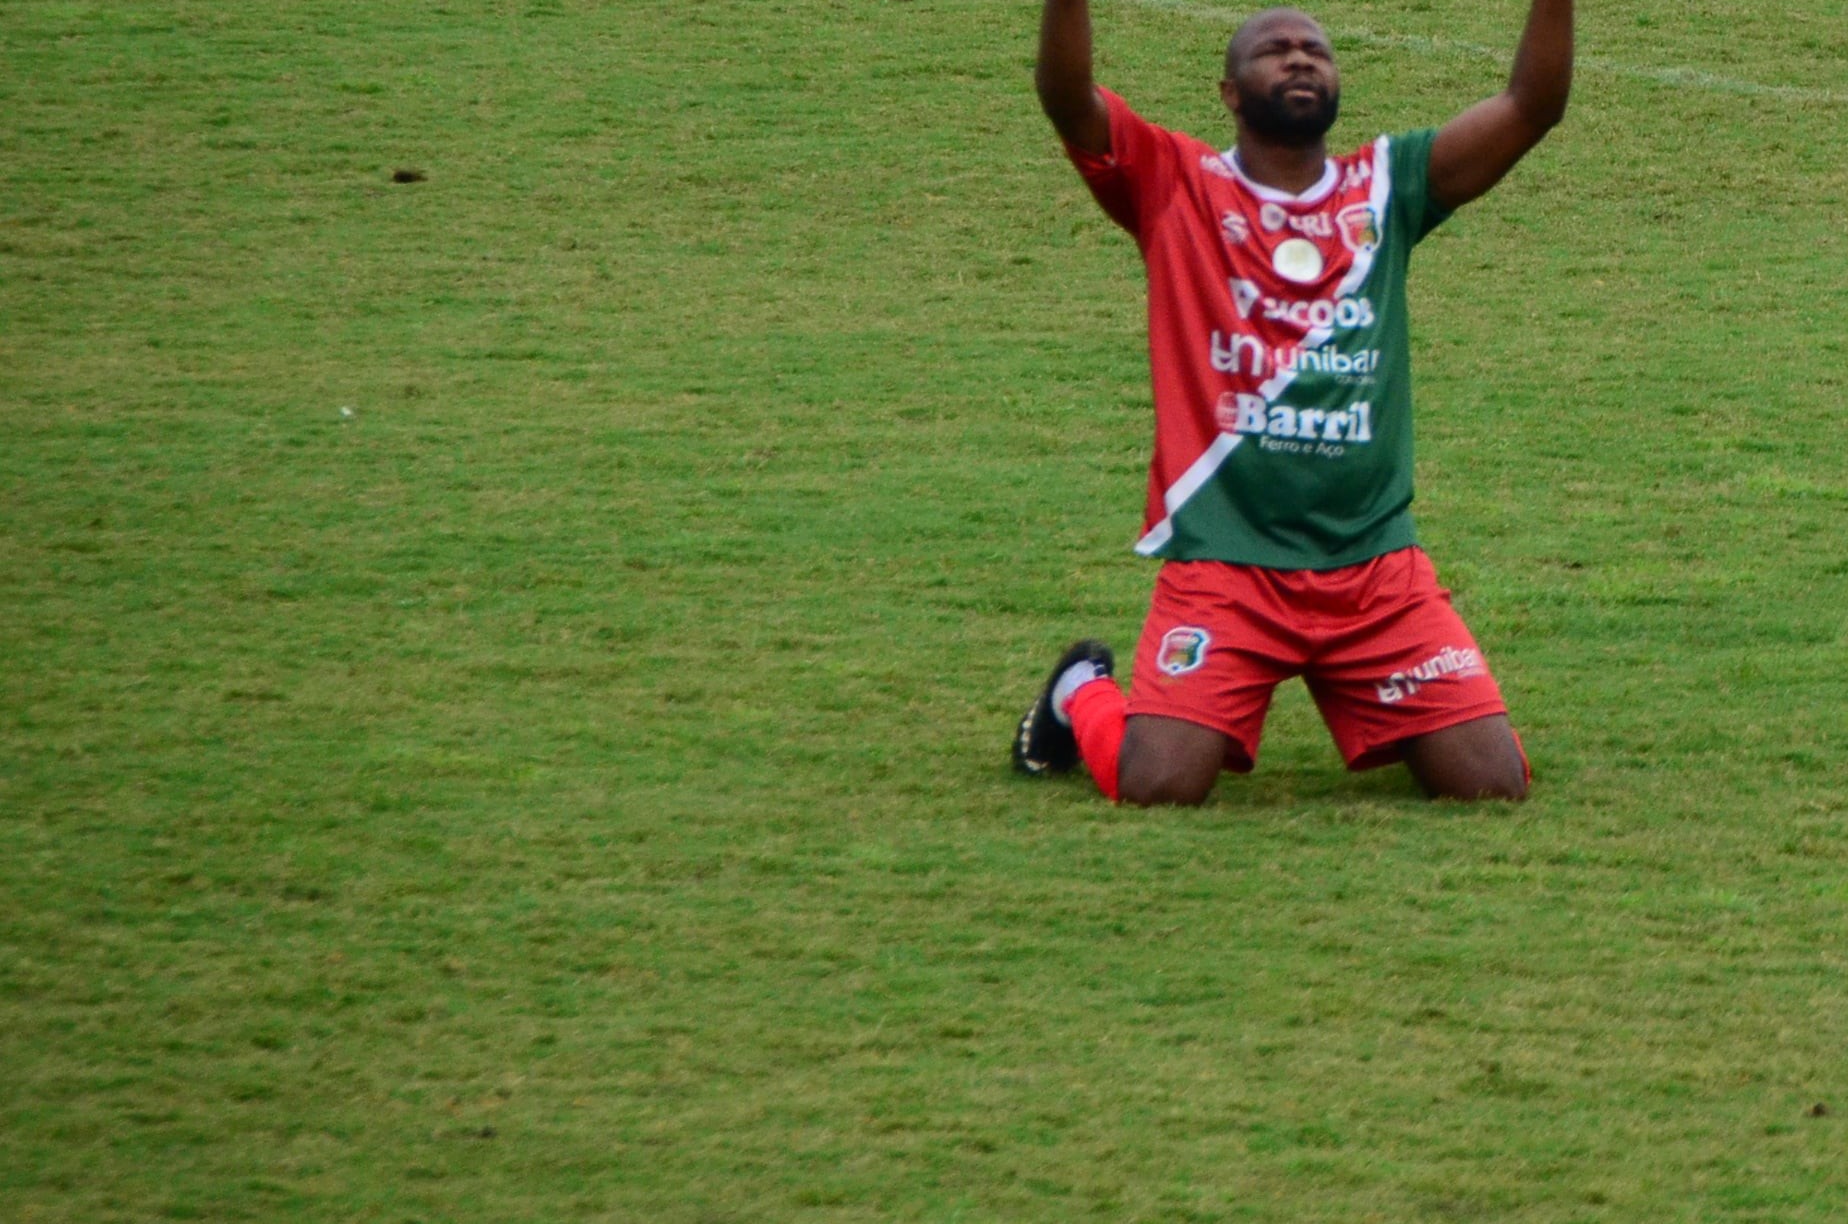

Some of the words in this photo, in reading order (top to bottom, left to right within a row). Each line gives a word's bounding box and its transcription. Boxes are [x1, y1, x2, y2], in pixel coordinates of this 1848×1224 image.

[1235, 392, 1372, 442] Barril
[1259, 436, 1300, 453] Ferro
[1316, 441, 1346, 458] Aço
